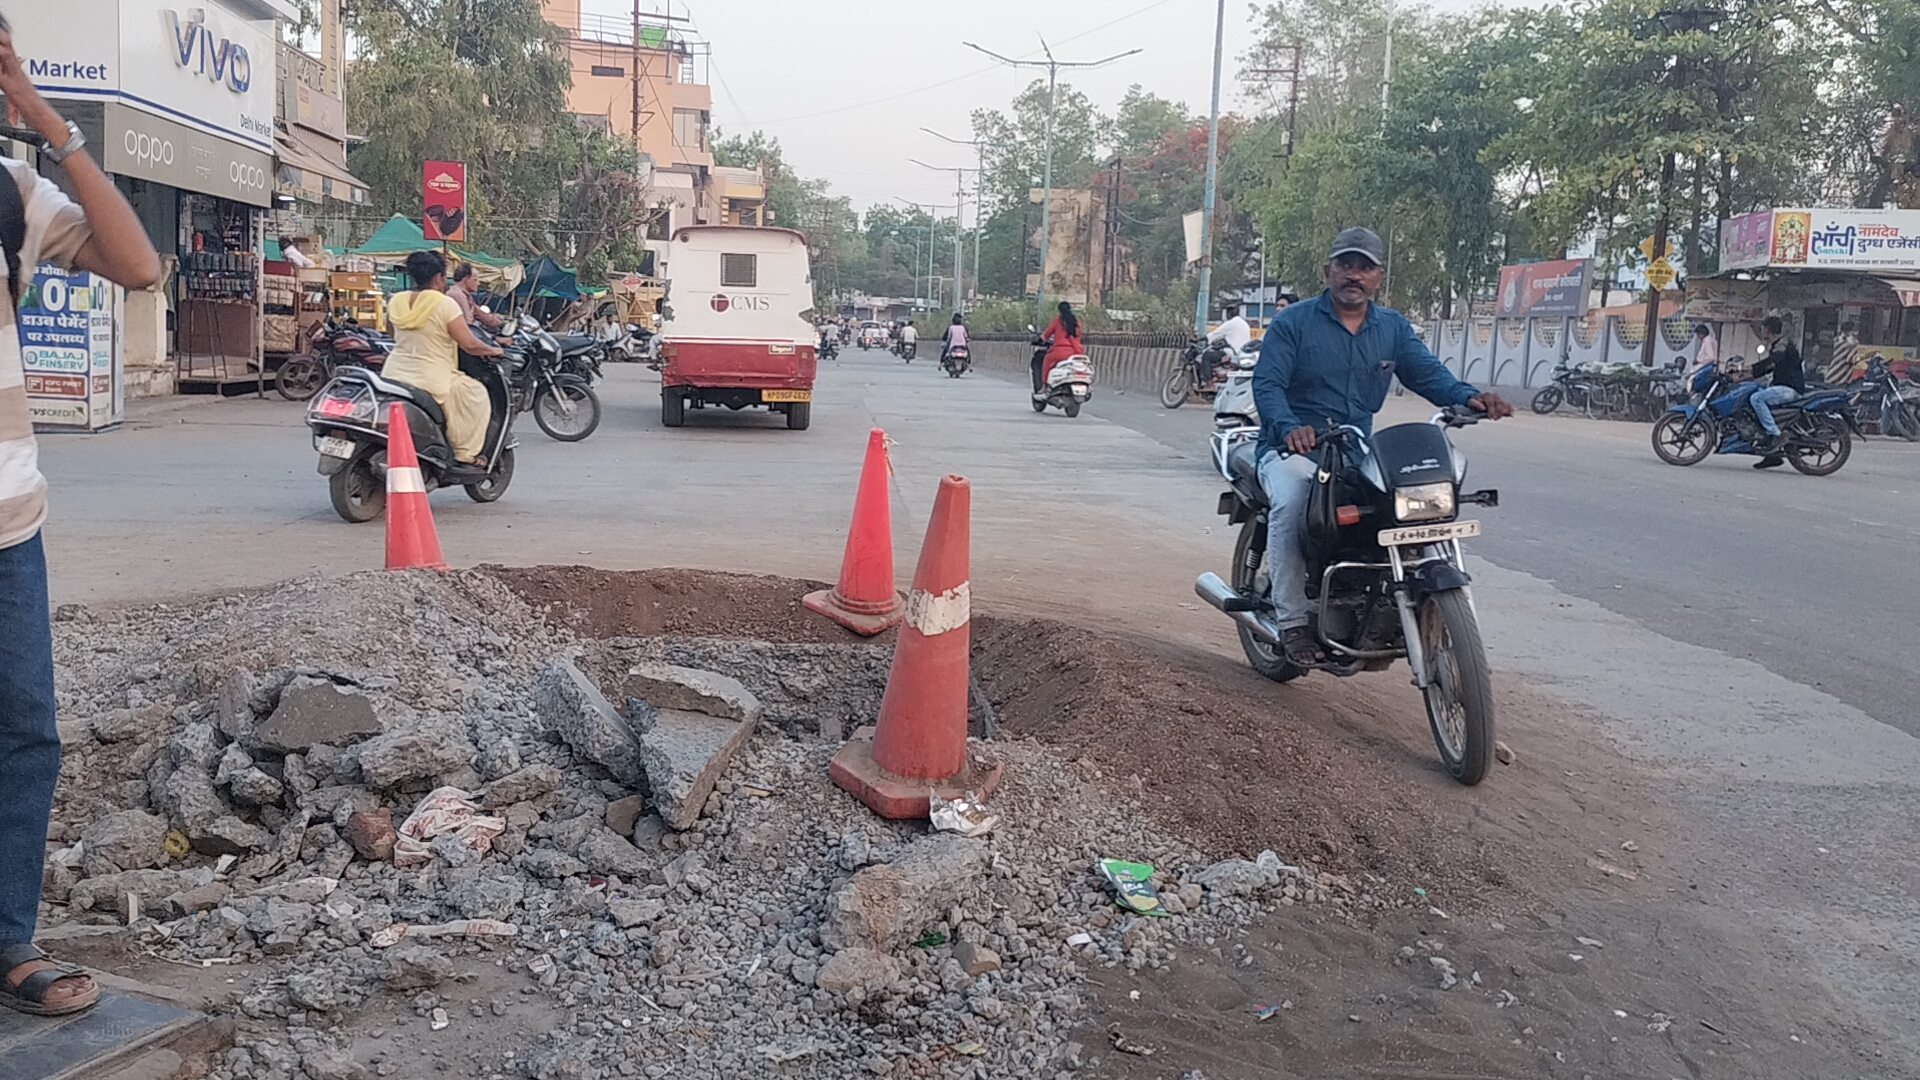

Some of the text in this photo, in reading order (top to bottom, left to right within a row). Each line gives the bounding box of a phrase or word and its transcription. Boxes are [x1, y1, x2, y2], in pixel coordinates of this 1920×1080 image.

[163, 8, 251, 93] vivo
[29, 58, 107, 81] Market
[240, 113, 272, 139] Delhi Market
[124, 129, 174, 168] oppo
[229, 160, 265, 193] oppo
[1858, 224, 1899, 238] नामदेव
[1857, 238, 1884, 253] दुग्ध
[731, 296, 770, 311] CMS
[21, 314, 55, 327] डाउन
[56, 313, 88, 328] पेमेंट
[26, 332, 43, 341] पर
[44, 333, 86, 344] उपलब्ध
[39, 350, 84, 360] BAJAJ
[39, 359, 84, 369] FINSERV
[62, 380, 82, 388] FIRST
[46, 409, 76, 417] CREDIT
